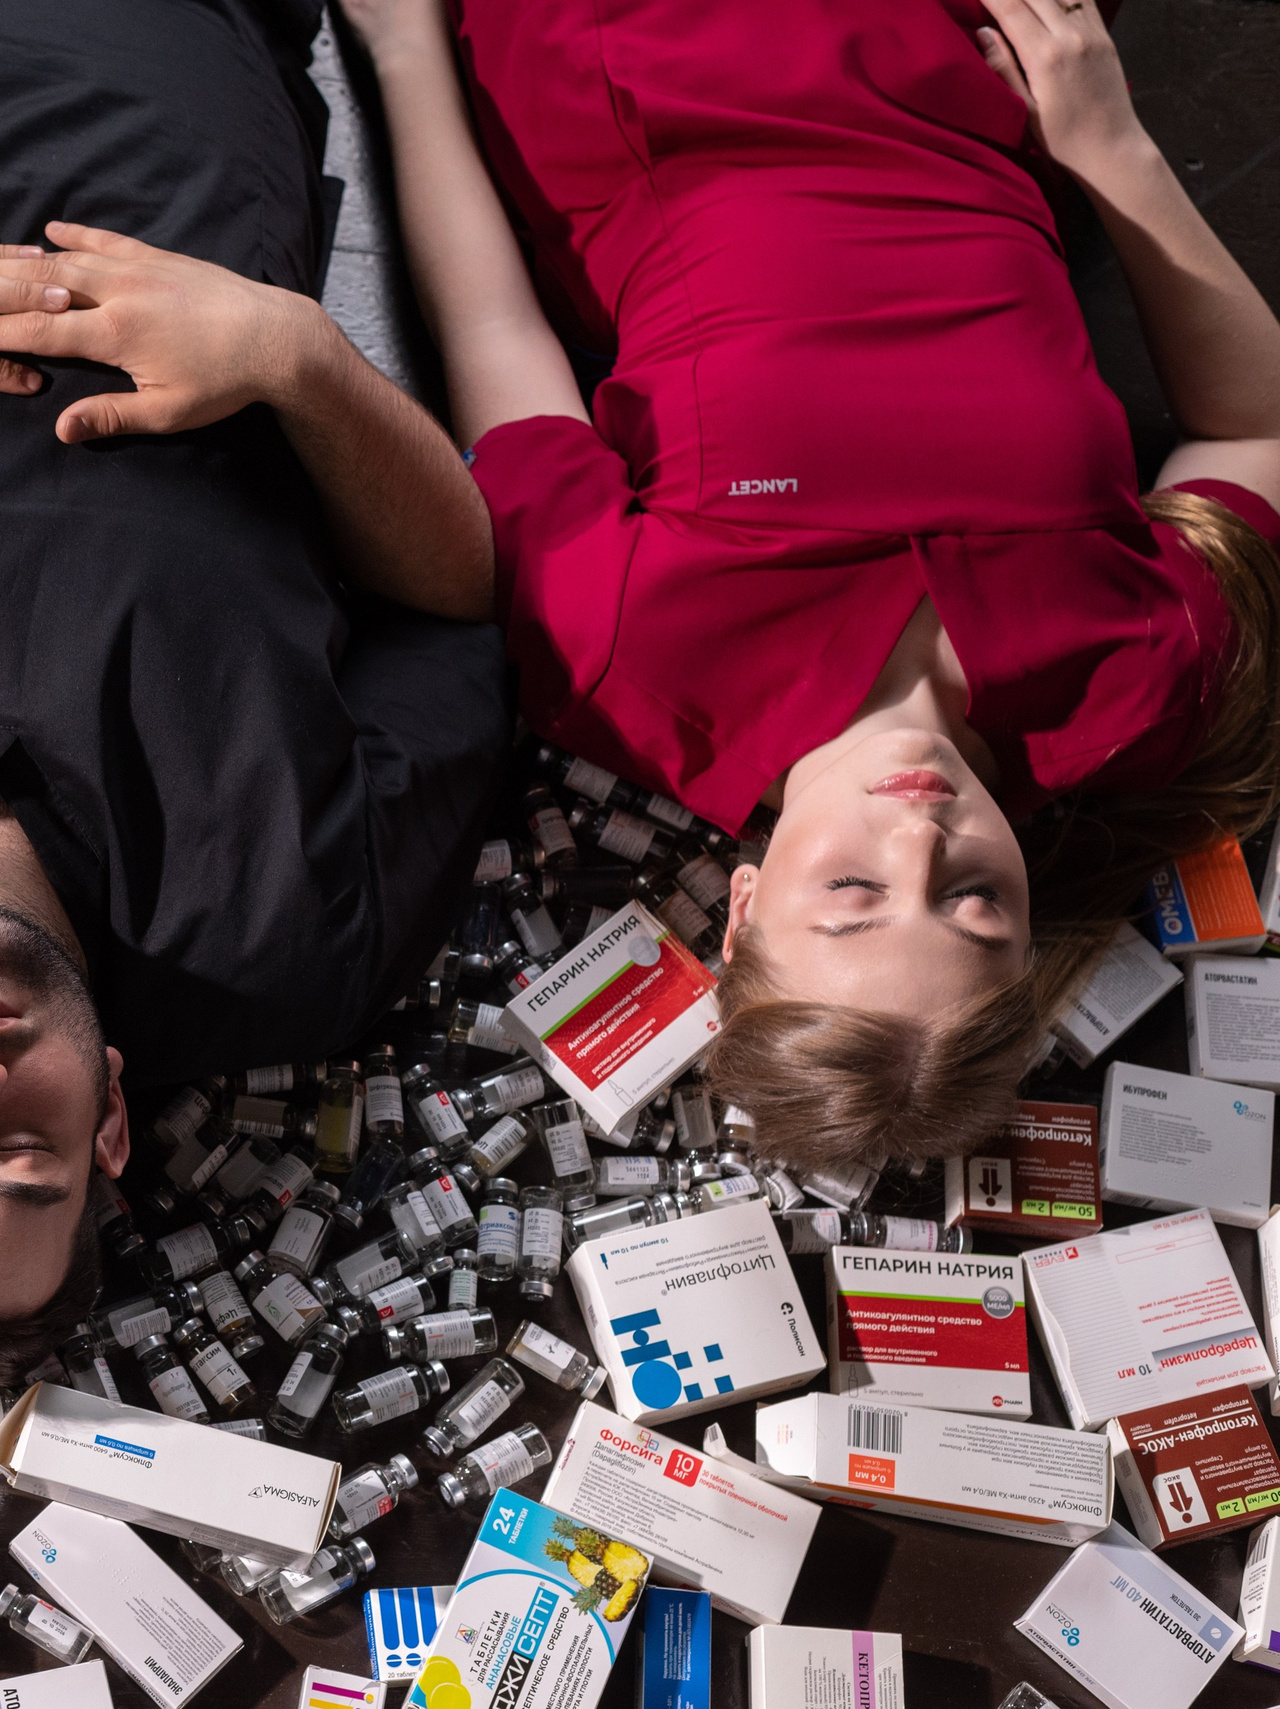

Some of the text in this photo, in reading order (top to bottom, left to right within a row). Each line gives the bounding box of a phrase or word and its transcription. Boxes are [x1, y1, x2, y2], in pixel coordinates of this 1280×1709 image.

[727, 478, 798, 495] LANCET
[526, 912, 641, 1013] ГЕПАРИН НАТРИЯ
[565, 965, 665, 1051] Антикоагулянтное средство
[574, 1001, 641, 1060] прямого действия
[1122, 1083, 1168, 1100] ИБУПРОФЕН
[1037, 1202, 1045, 1212] 2
[1077, 1205, 1093, 1216] 50
[619, 1245, 629, 1254] 10
[629, 1243, 639, 1252] по
[659, 1235, 669, 1244] 10
[841, 1255, 1014, 1280] ГЕПАРИН НАТРИЯ
[845, 1308, 982, 1327] Антикоагулянтное средство
[846, 1320, 935, 1335] прямого действия
[787, 1317, 804, 1357] Полисан
[190, 1344, 222, 1372] таксим
[1116, 1362, 1153, 1380] 10 мл
[1239, 1363, 1266, 1378] Раствор
[1163, 1410, 1197, 1427] ketoprofen
[1211, 1397, 1249, 1414] кетопрофен
[1137, 1412, 1258, 1455] Кетопрофен-АКОС
[593, 1440, 646, 1470] Дапаглифлозин
[596, 1425, 665, 1469] Форсига
[590, 1448, 637, 1476] (Dapagliflozin)
[671, 1467, 689, 1481] мг
[672, 1452, 696, 1473] 10
[700, 1468, 736, 1491] 30 таблеток,
[854, 1470, 887, 1483] 0,4 мл
[960, 1484, 972, 1493] мл
[260, 1483, 320, 1509] ALFASIGMA
[698, 1475, 788, 1523] покрытых пленочной оболочкой
[1027, 1495, 1046, 1505] 4250
[1219, 1501, 1240, 1512] 2 мл
[490, 1504, 516, 1535] 24
[507, 1506, 529, 1545] ТАБЛЕТКИ
[30, 1528, 53, 1550] OZON
[1044, 1603, 1073, 1629] OZON
[1109, 1572, 1216, 1665] АТОРВАСТАТИН 40 МГ
[1168, 1592, 1202, 1622] 30 ТАБЛЕТОК
[468, 1609, 503, 1675] ТАБЛЕТКИ
[475, 1666, 489, 1683] ДЛЯ
[482, 1610, 511, 1668] РАССАСЫВАНИЯ
[483, 1614, 522, 1690] АНАНАСОВЫЕ
[492, 1587, 558, 1709] ДЖИСЕПТ
[520, 1605, 571, 1709] СЕПТИЧЕСКОЕ СРЕДСТВО
[557, 1634, 581, 1677] ПРИМЕНЕНИЯ
[576, 1646, 593, 1677] ПОЛОСТИ
[141, 1654, 185, 1697] ЭНАЛАПРИЛ
[396, 1670, 416, 1678] таблет
[578, 1667, 593, 1693] ГЛОТКИ
[857, 1651, 870, 1709] КЕТОПР
